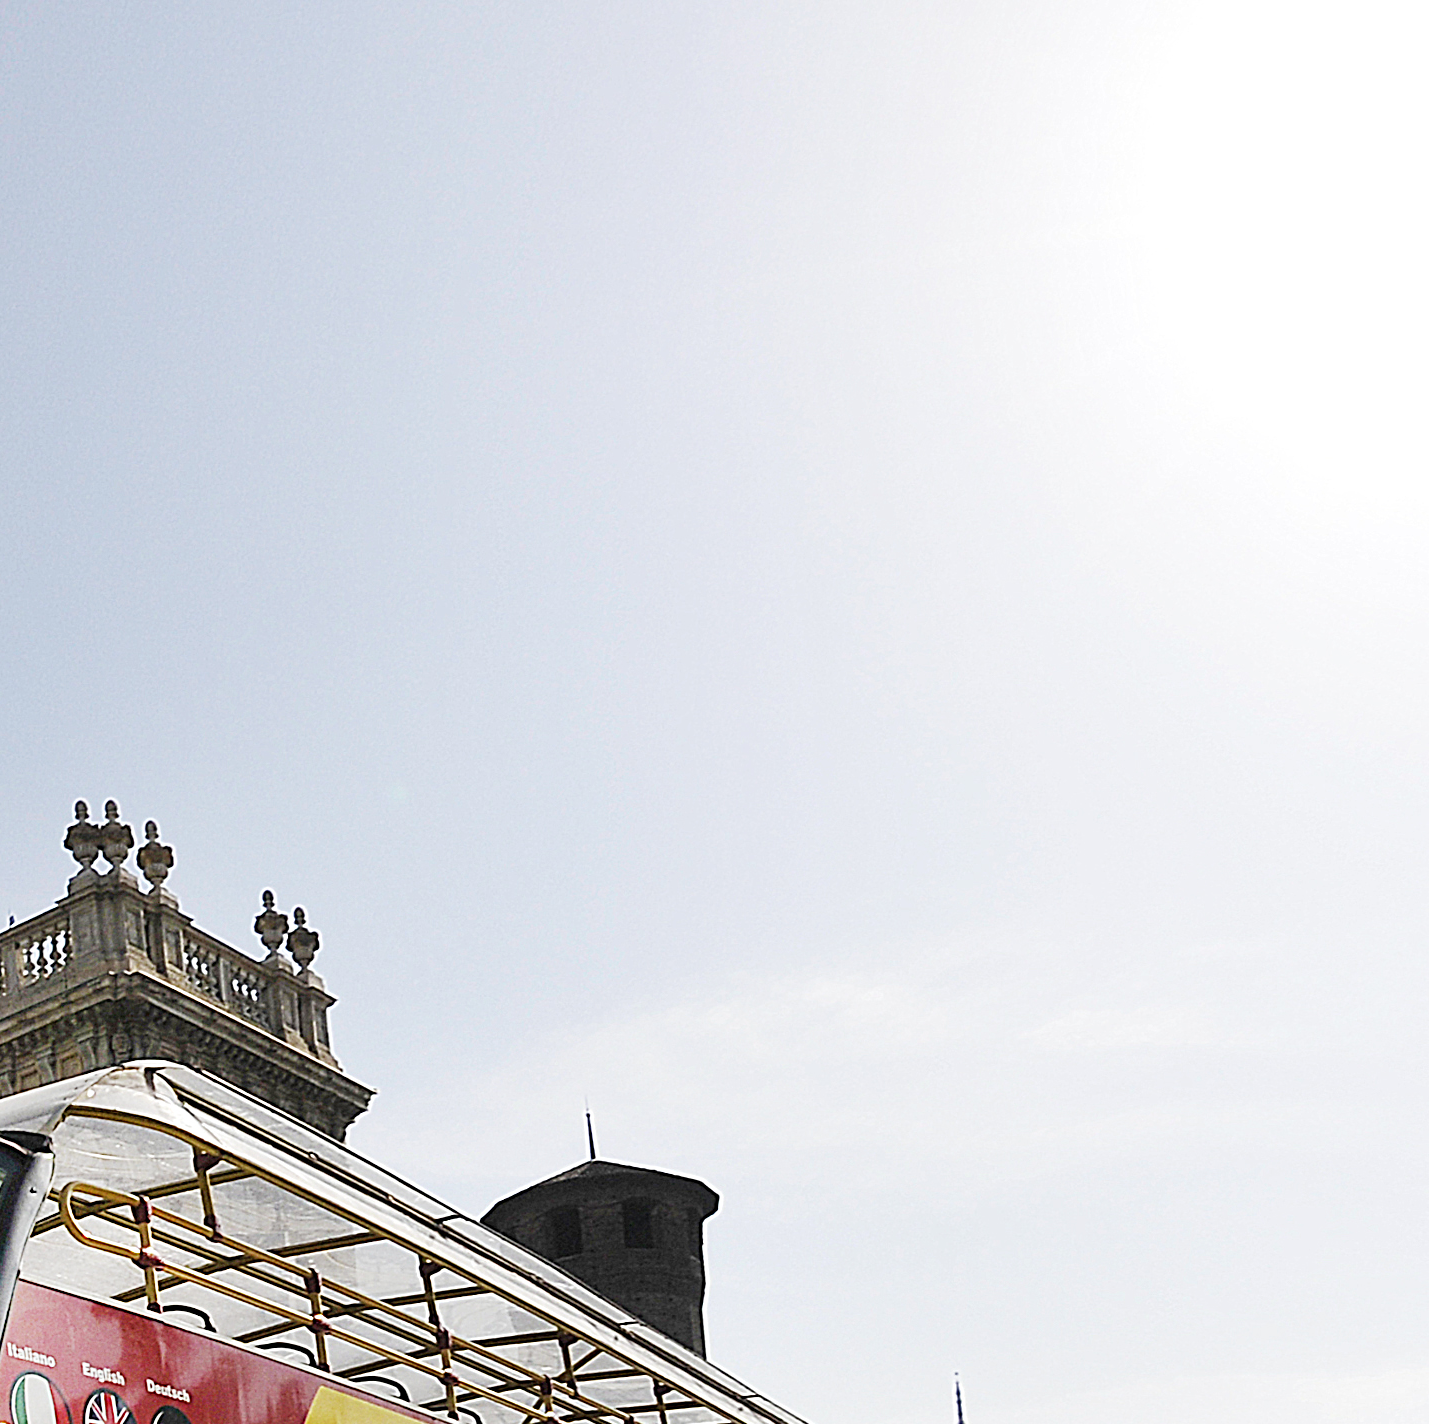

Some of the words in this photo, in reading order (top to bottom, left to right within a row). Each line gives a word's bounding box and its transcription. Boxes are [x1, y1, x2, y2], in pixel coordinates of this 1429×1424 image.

[6, 1341, 57, 1368] Italiano
[81, 1361, 126, 1387] English
[145, 1378, 191, 1403] Deutsch
